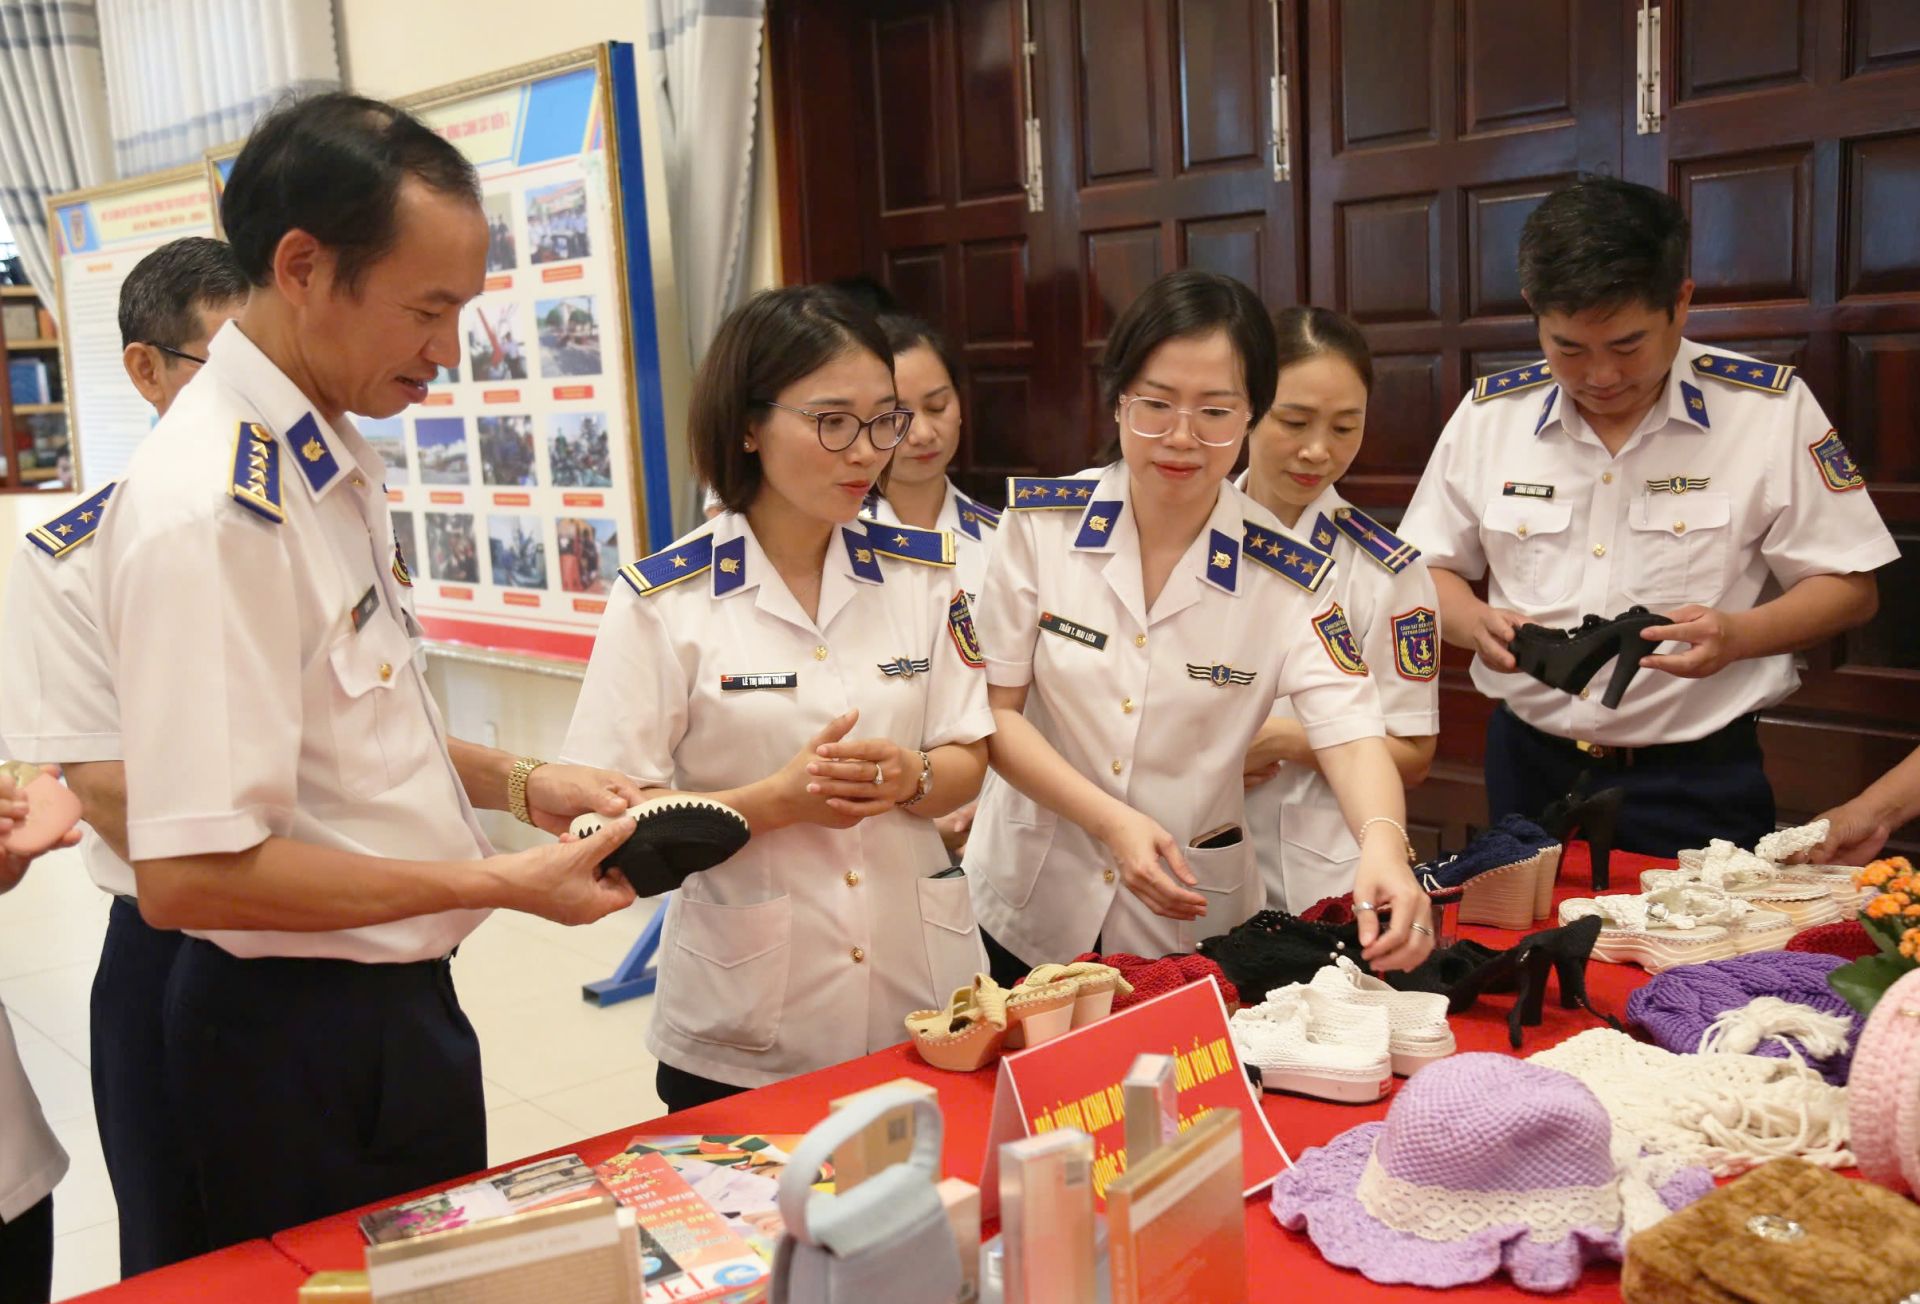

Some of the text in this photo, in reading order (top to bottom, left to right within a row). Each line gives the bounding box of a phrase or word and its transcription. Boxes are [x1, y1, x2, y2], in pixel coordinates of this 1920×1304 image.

[1080, 1089, 1114, 1132] KINH
[1189, 1036, 1216, 1083] VỐN
[1209, 1037, 1233, 1075] VAY
